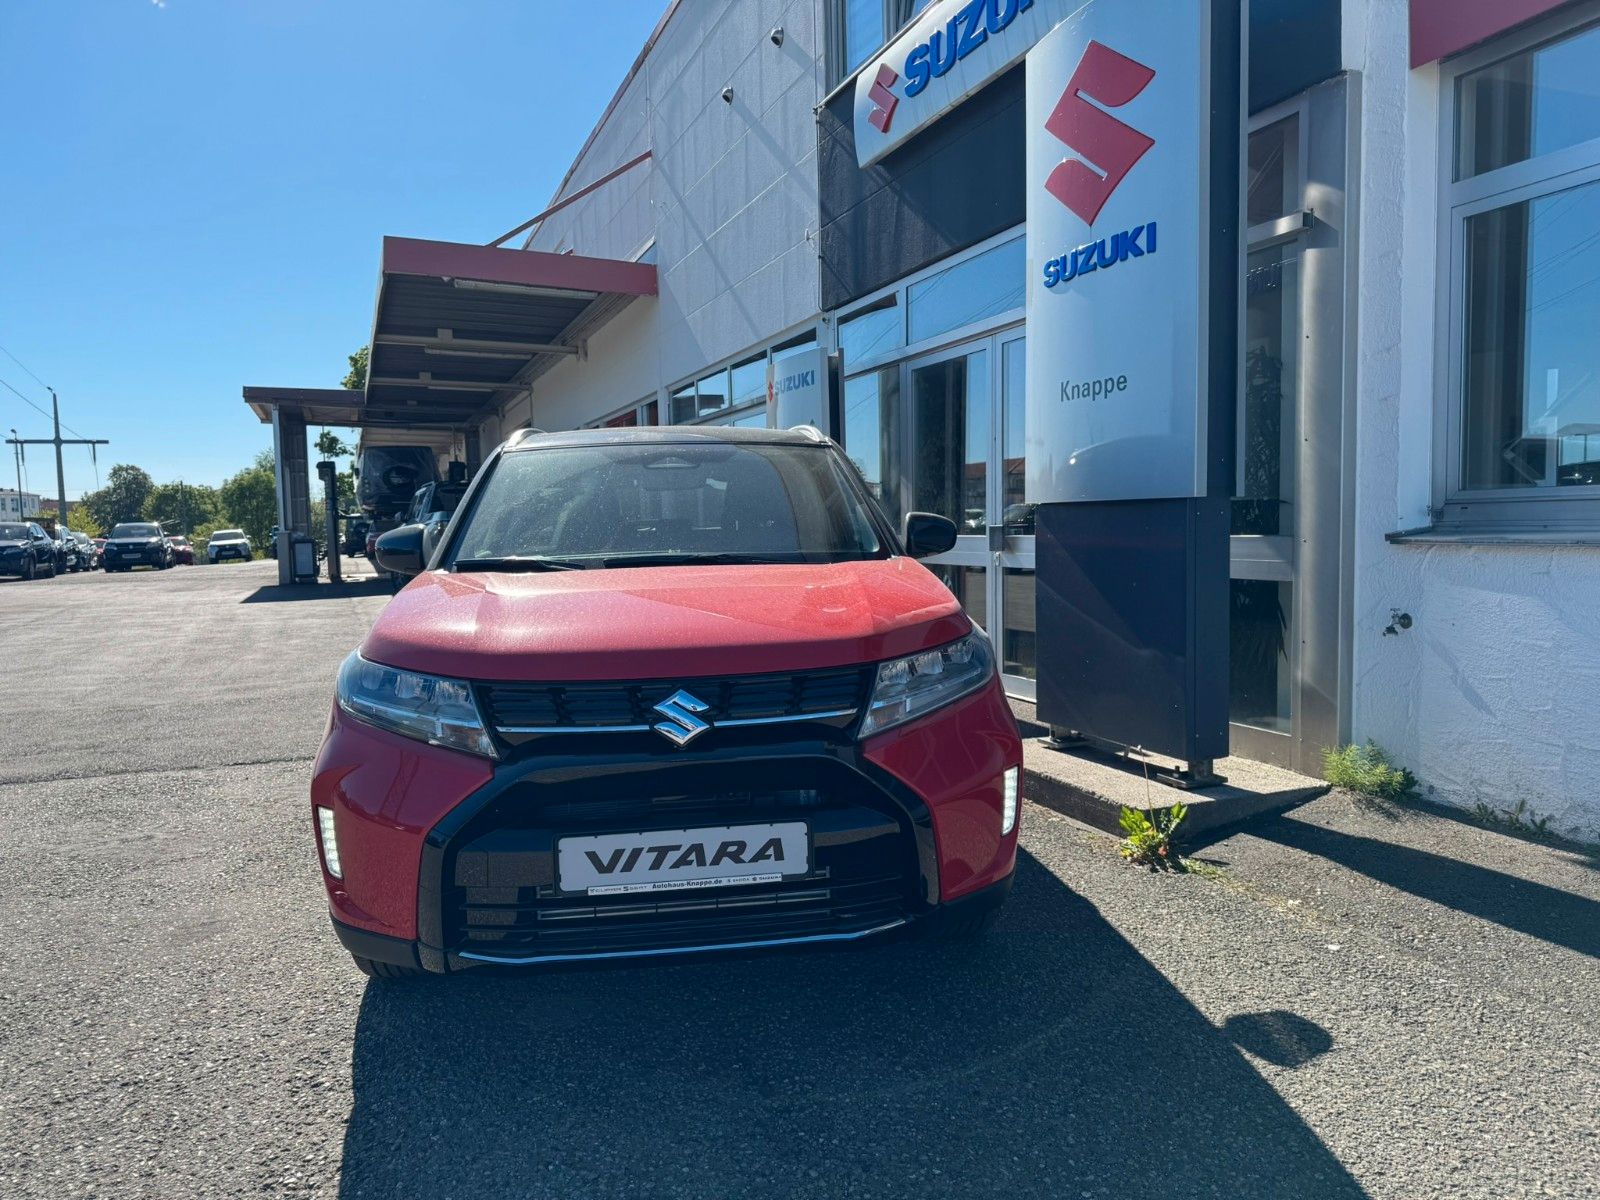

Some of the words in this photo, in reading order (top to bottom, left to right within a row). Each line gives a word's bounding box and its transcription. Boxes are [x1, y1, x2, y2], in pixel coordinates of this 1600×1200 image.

[904, 0, 1033, 98] SUZU
[1043, 222, 1157, 288] SUZUKI
[775, 369, 815, 396] SUZUKI
[1060, 373, 1128, 402] Knappe
[584, 837, 785, 874] VITARA
[652, 878, 723, 889] Autohaus-Knappe.de
